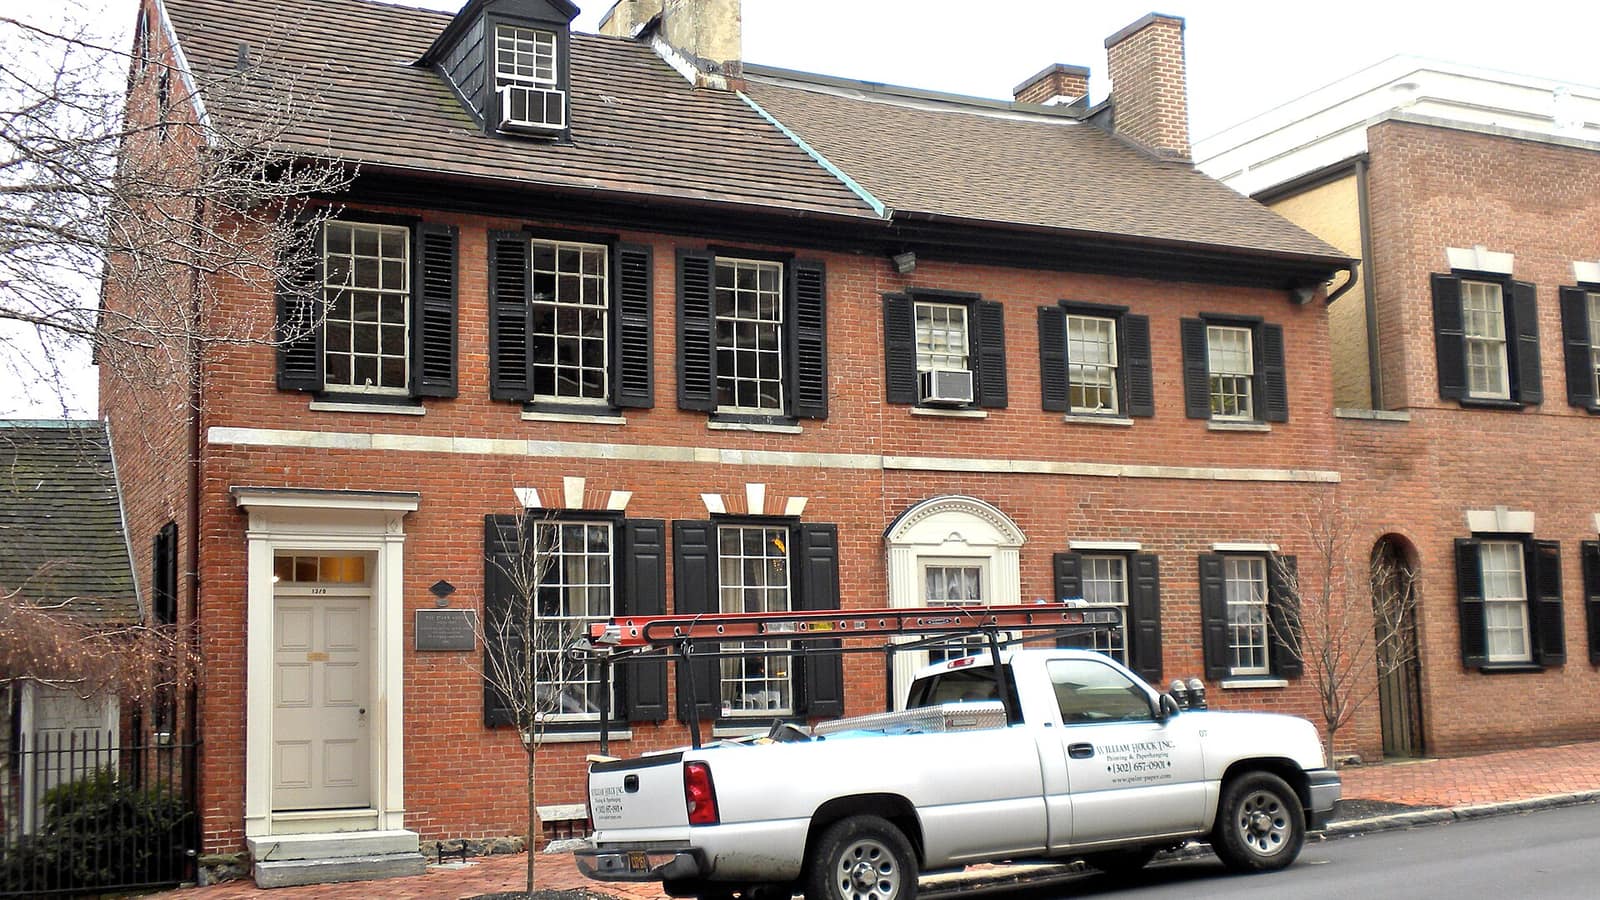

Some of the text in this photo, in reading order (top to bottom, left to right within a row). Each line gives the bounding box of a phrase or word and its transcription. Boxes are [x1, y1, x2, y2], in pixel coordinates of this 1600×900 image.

[1096, 743, 1130, 754] WILLIAM
[1131, 741, 1158, 753] HOUCK
[1112, 760, 1166, 774] (302) 657-0901
